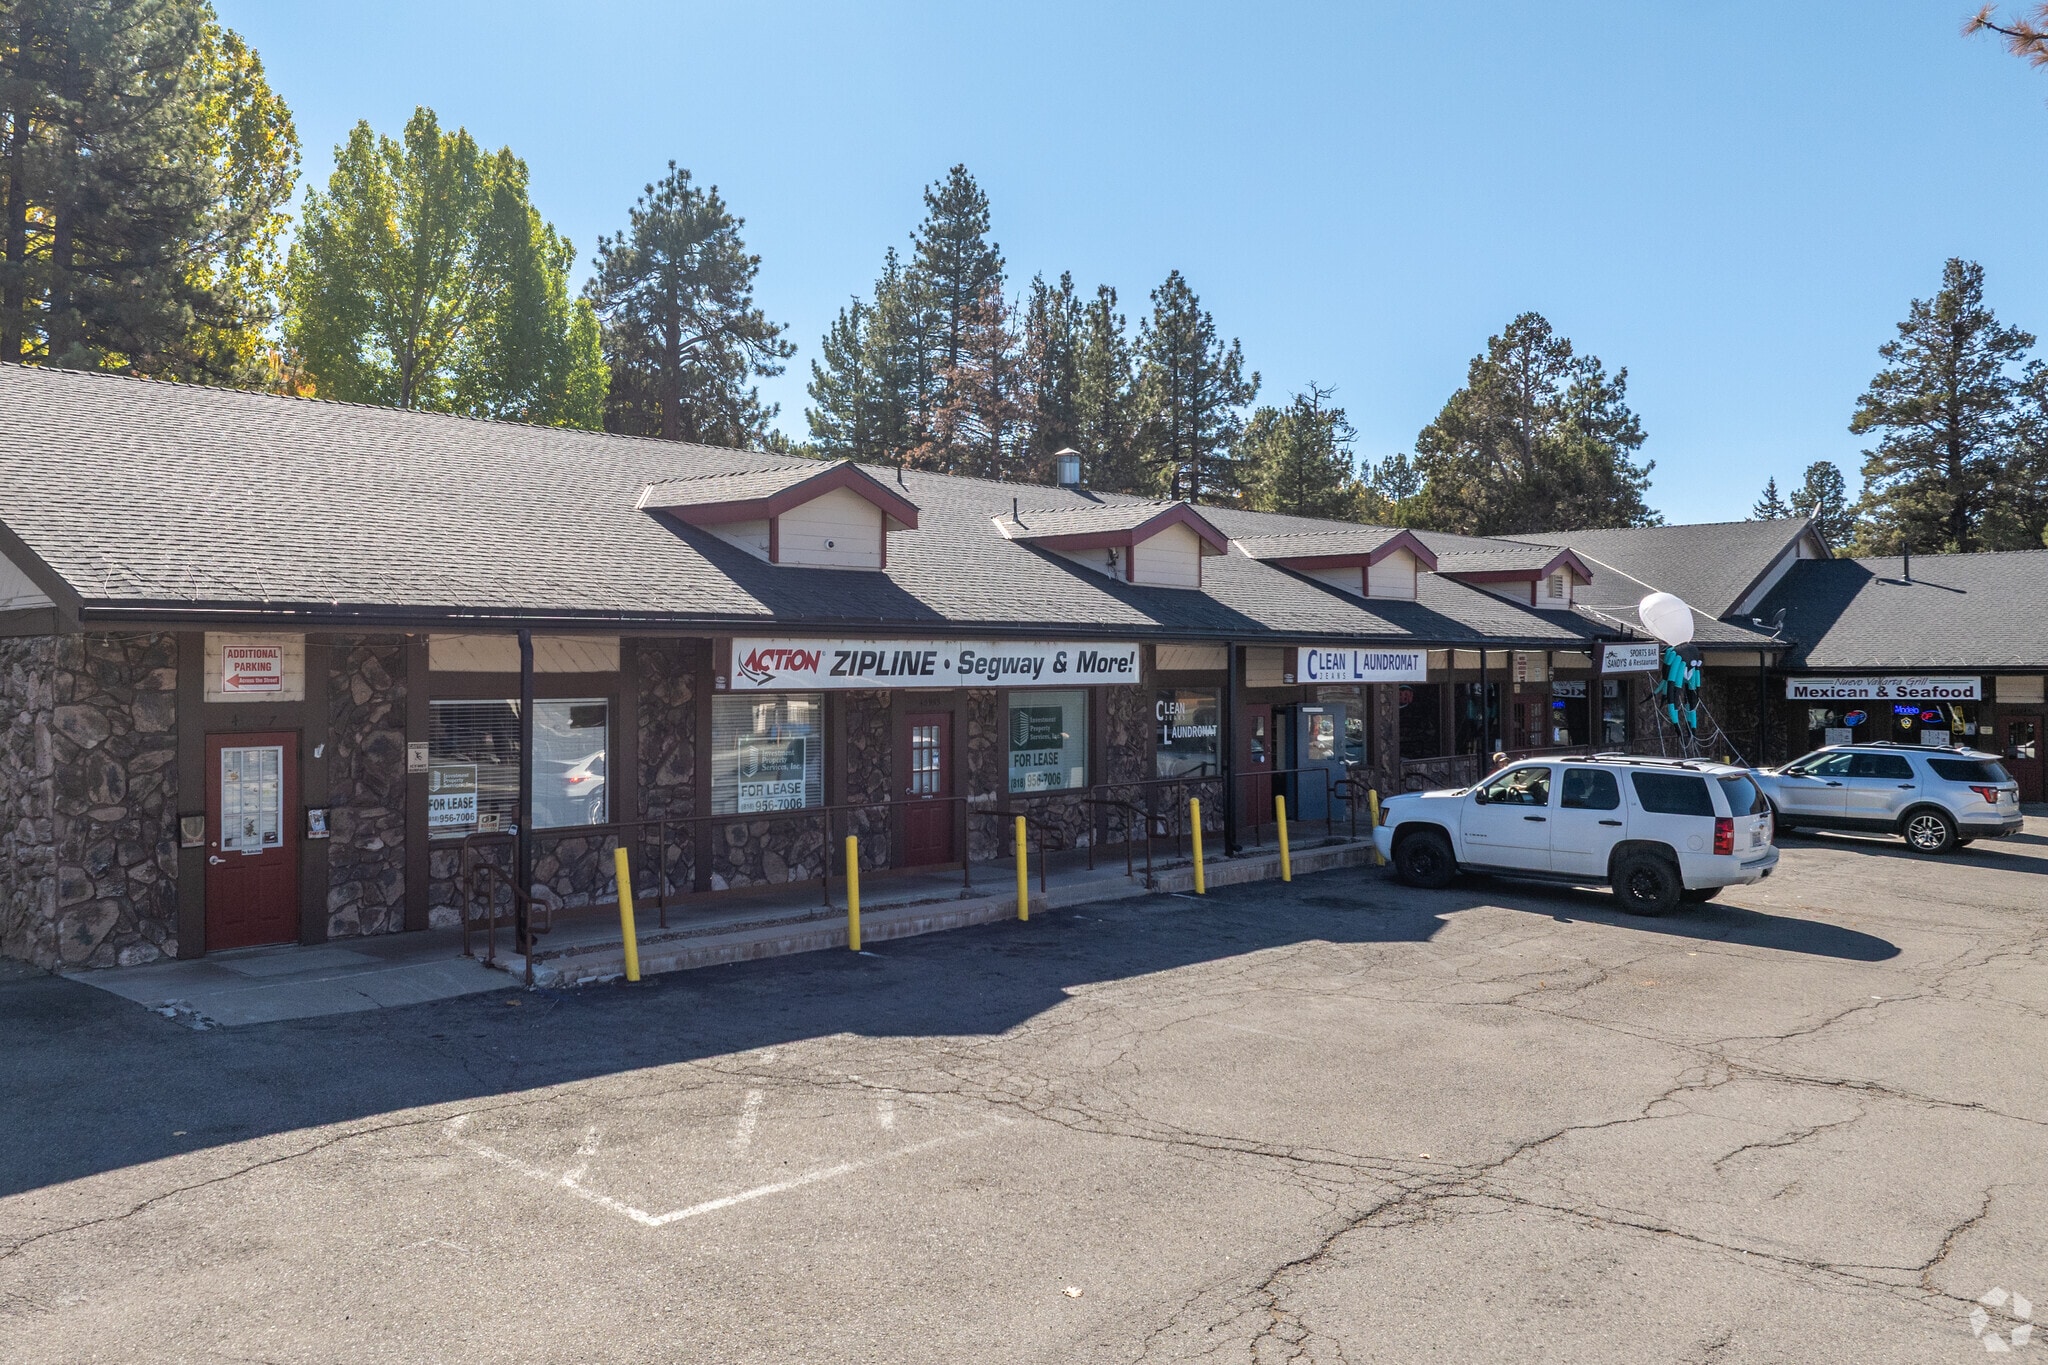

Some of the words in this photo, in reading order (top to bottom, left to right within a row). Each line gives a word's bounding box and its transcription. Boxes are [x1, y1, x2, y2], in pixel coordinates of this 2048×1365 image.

[227, 649, 279, 659] ADDITIONAL
[1630, 648, 1647, 657] SPORTS
[1648, 648, 1657, 656] BAR
[234, 662, 272, 672] PARKING
[737, 648, 821, 677] ACTION
[830, 651, 937, 676] ZIPLINE
[958, 650, 1045, 681] Segway
[1052, 651, 1068, 673] &
[1076, 650, 1135, 673] More!
[1307, 649, 1346, 680] CLEAN
[1353, 650, 1419, 679] LAUNDROMAT
[1607, 658, 1627, 668] SANDY'S
[263, 676, 278, 684] Street
[1834, 677, 1863, 686] Nuevo
[1906, 677, 1928, 688] Grill
[1793, 686, 1869, 698] Mexican
[1876, 686, 1889, 698] &
[1896, 686, 1974, 698] Seafood
[1156, 700, 1186, 721] CLEAN
[1894, 704, 1920, 715] Modelo
[1029, 725, 1051, 733] Property
[1164, 724, 1218, 745] LAUNDROMAT
[761, 757, 787, 765] Property
[1014, 754, 1032, 768] FOR
[1033, 752, 1059, 766] LEASE
[761, 764, 789, 772] Services,
[1010, 778, 1026, 792] (818)
[1027, 772, 1061, 787] 956-7006
[741, 785, 763, 797] FOR
[766, 783, 802, 795] LEASE
[429, 799, 446, 812] FOR
[447, 797, 474, 810] LEASE
[755, 798, 802, 812] 956-7006
[440, 813, 475, 823] 956-7006
